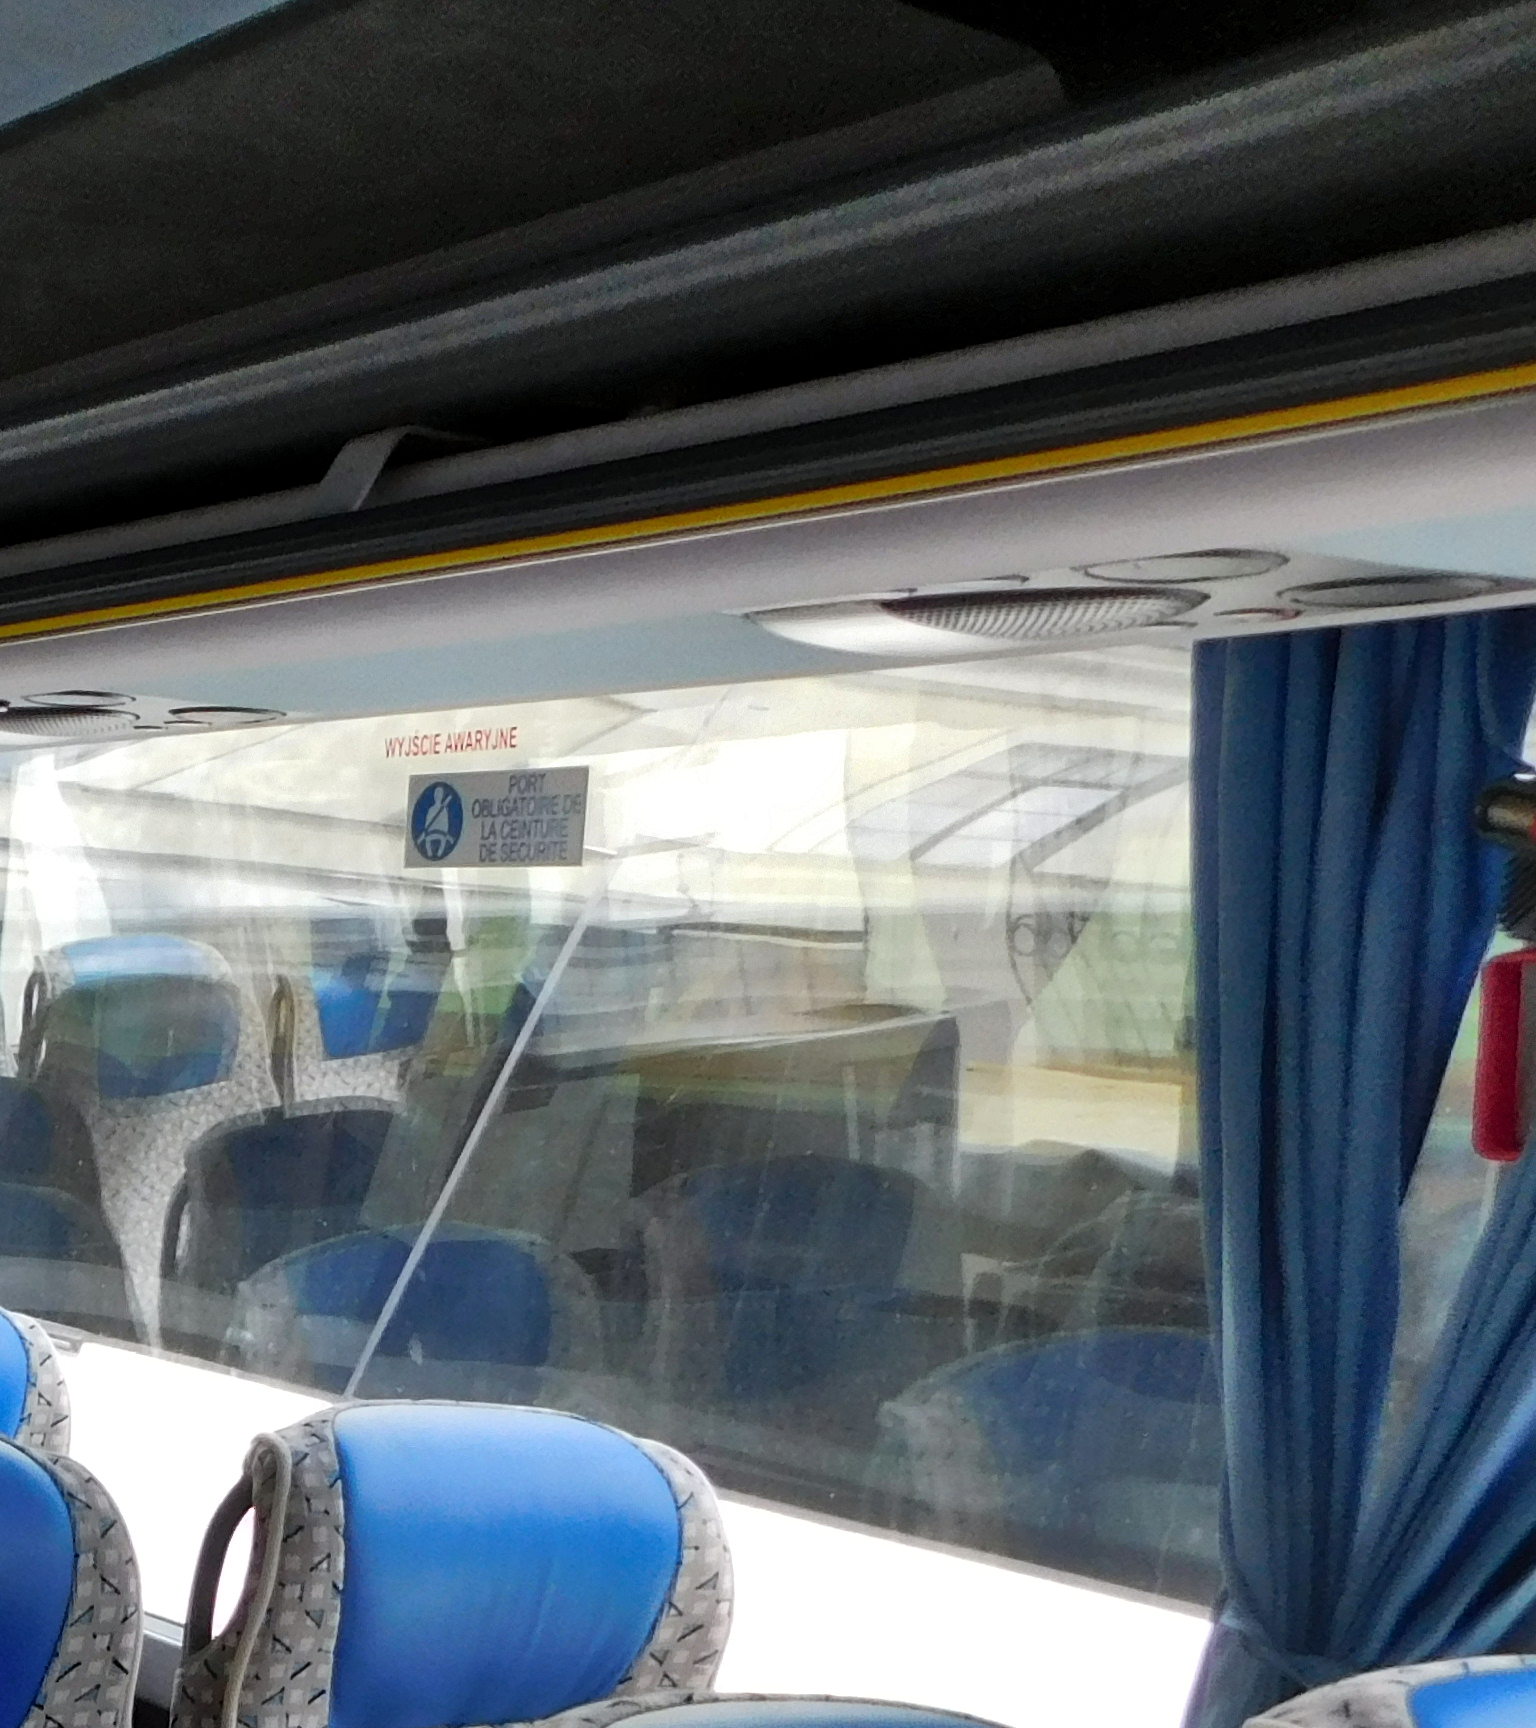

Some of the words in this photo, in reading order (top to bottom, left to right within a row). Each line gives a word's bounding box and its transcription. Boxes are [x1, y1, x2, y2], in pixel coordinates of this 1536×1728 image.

[385, 730, 441, 758] WYJŚCIE
[444, 726, 518, 754] AWARYJNE
[508, 773, 546, 794] PORT
[471, 795, 560, 818] OBLIGATOIRE
[562, 793, 583, 815] DE
[480, 820, 497, 841] LA
[500, 817, 568, 840] CEINTURE
[479, 842, 497, 862] DE
